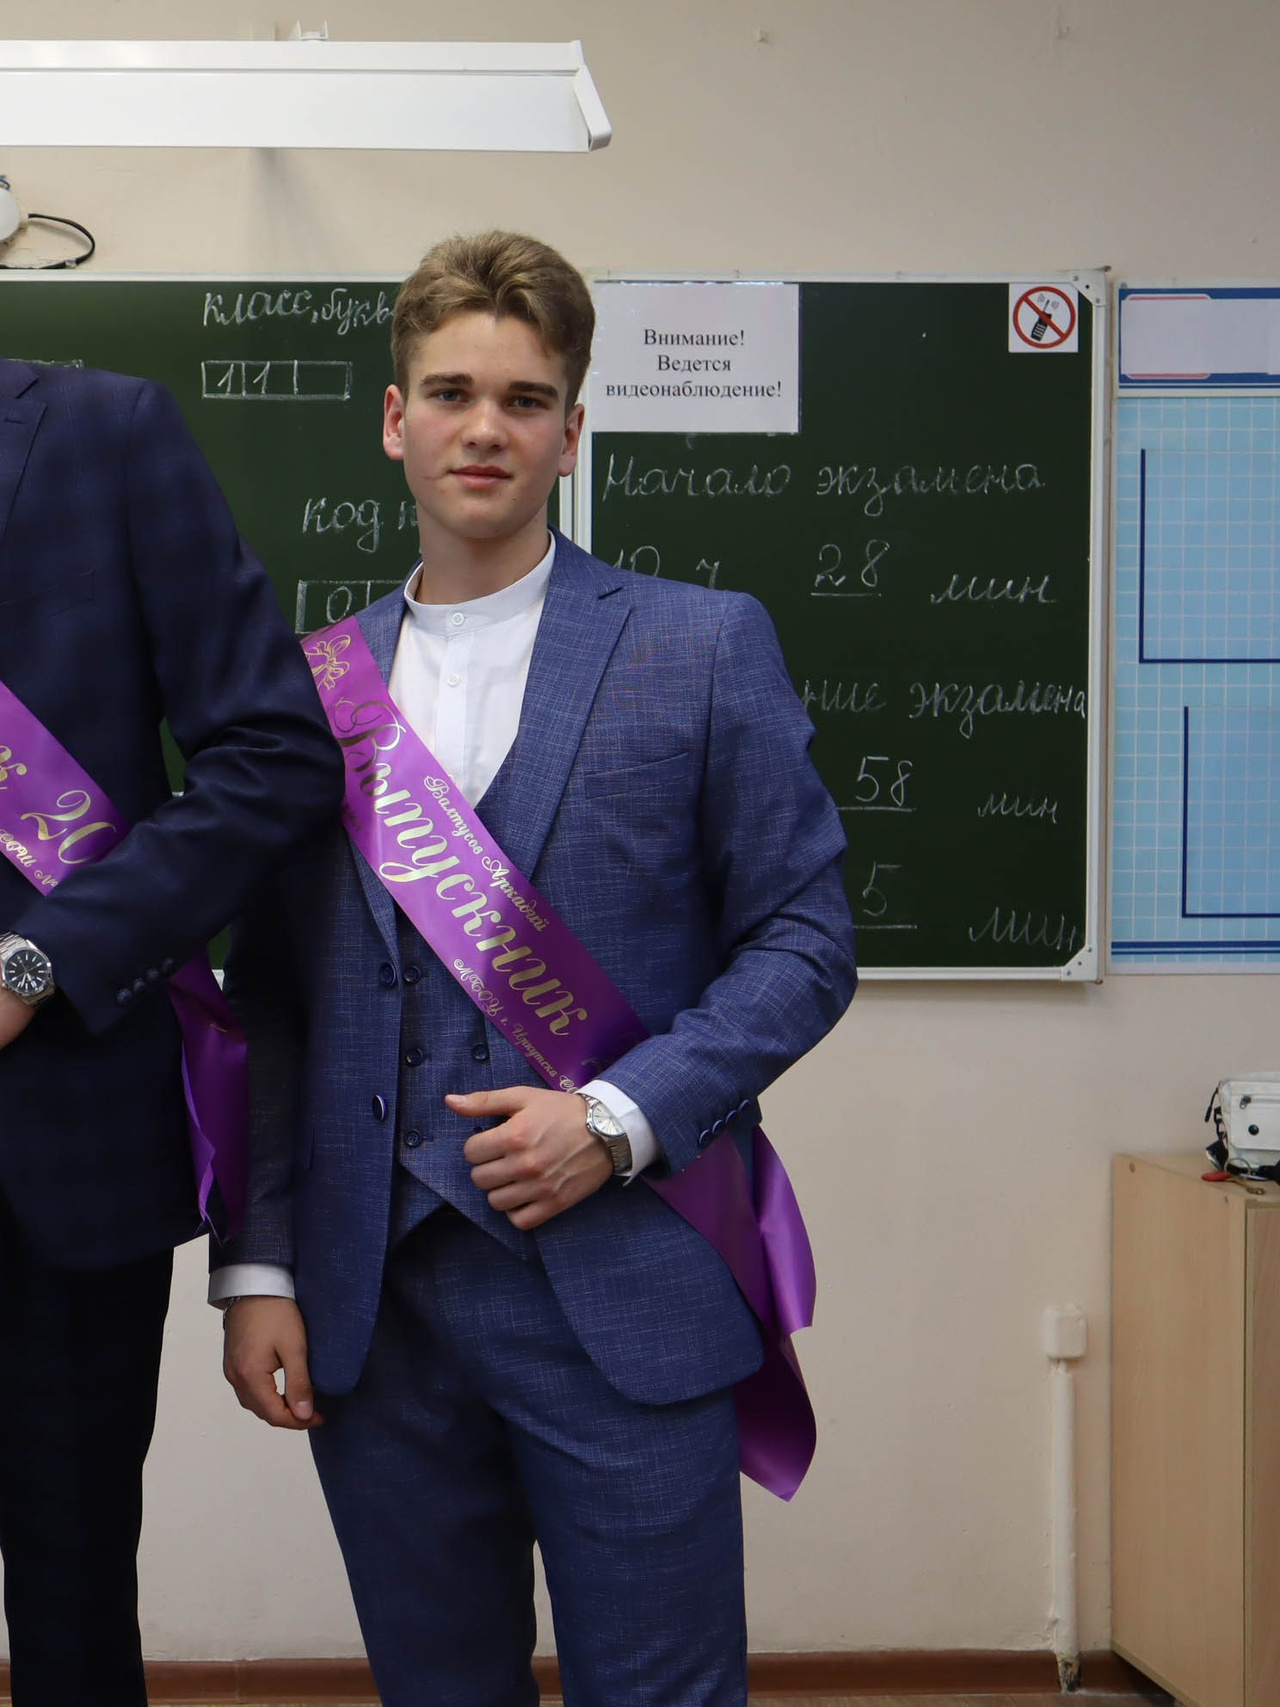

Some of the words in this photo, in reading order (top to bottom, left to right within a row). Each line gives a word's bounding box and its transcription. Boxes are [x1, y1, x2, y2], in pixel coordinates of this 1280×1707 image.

[643, 329, 746, 347] Внимание!
[656, 355, 731, 373] Ведется
[605, 380, 783, 399] видеонаблюдение!
[602, 453, 791, 502] Начало
[855, 756, 913, 807] 58
[334, 696, 588, 1036] Выпускник
[482, 856, 550, 932] Аркадий
